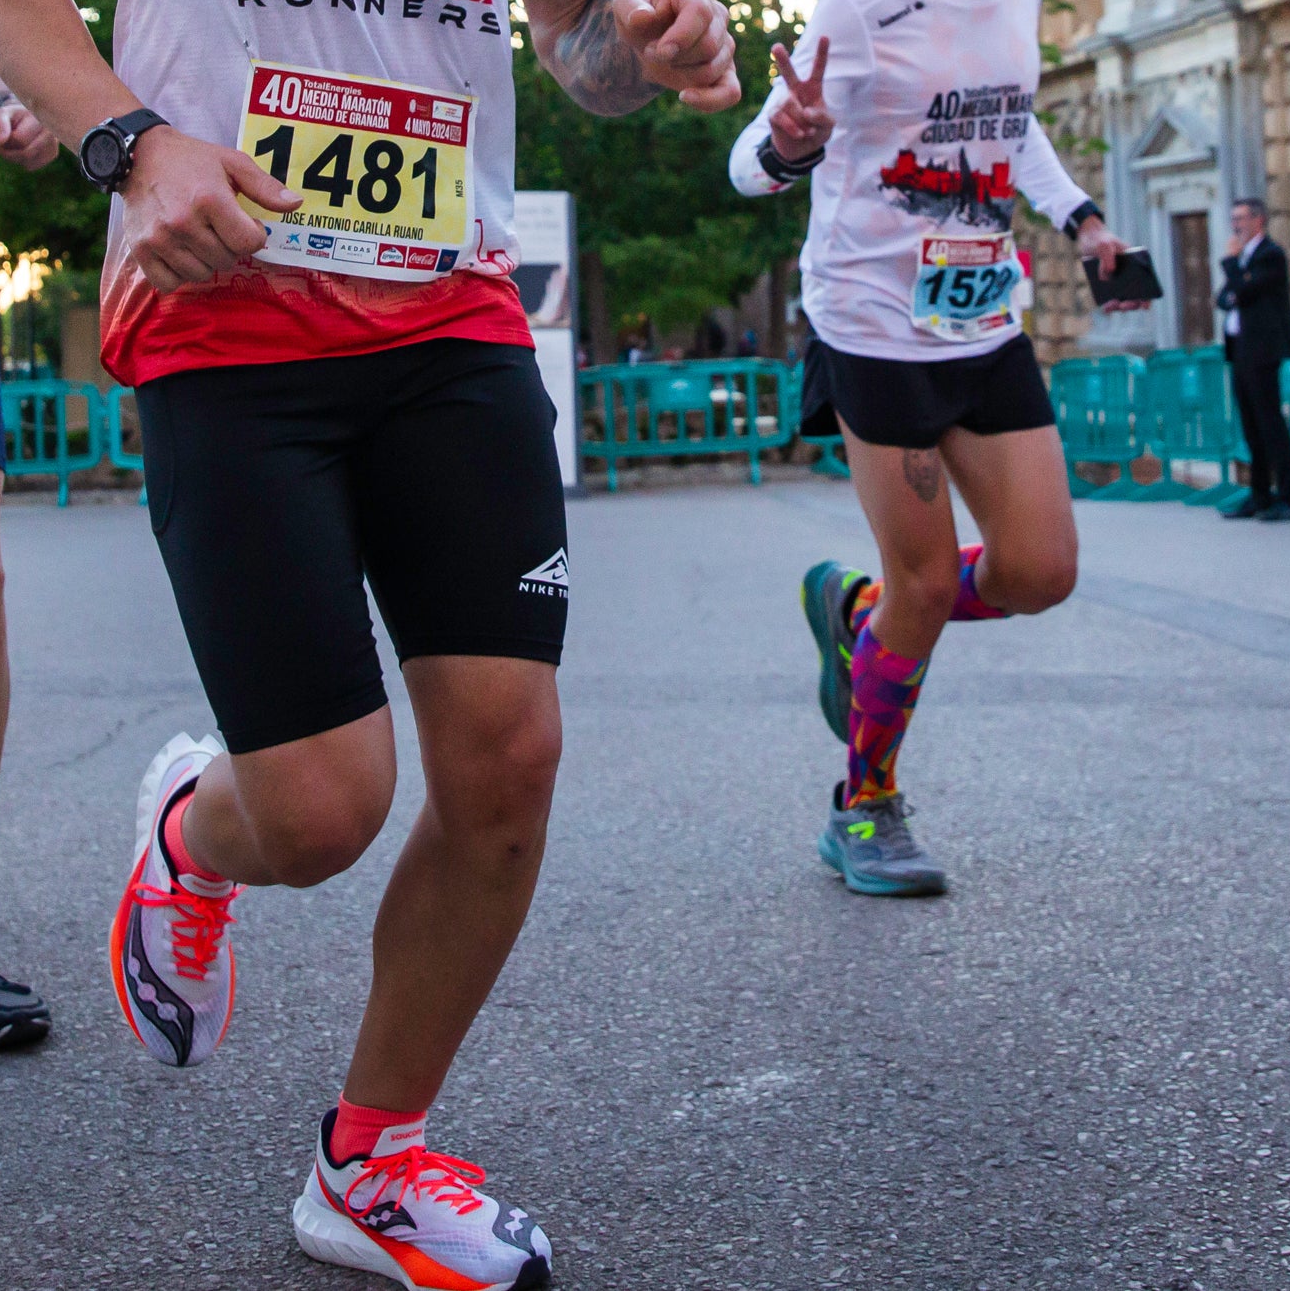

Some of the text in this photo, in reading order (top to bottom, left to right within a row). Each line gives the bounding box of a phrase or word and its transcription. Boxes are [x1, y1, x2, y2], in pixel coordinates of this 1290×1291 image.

[258, 74, 302, 116] 40
[303, 79, 362, 96] TotalEnergies
[301, 89, 340, 108] MEDIA
[341, 95, 392, 117] MARATÓN
[927, 90, 961, 121] 40
[299, 104, 390, 130] CIUDAD DE GRANADA
[405, 117, 450, 140] 4 MAYO 2024
[980, 119, 998, 141] DE
[254, 125, 438, 219] 1481
[456, 179, 464, 198] M35
[281, 211, 424, 241] JOSE ANTONIO CARILLA RUANO
[341, 244, 371, 254] AEDAS
[518, 581, 555, 596] NIKE
